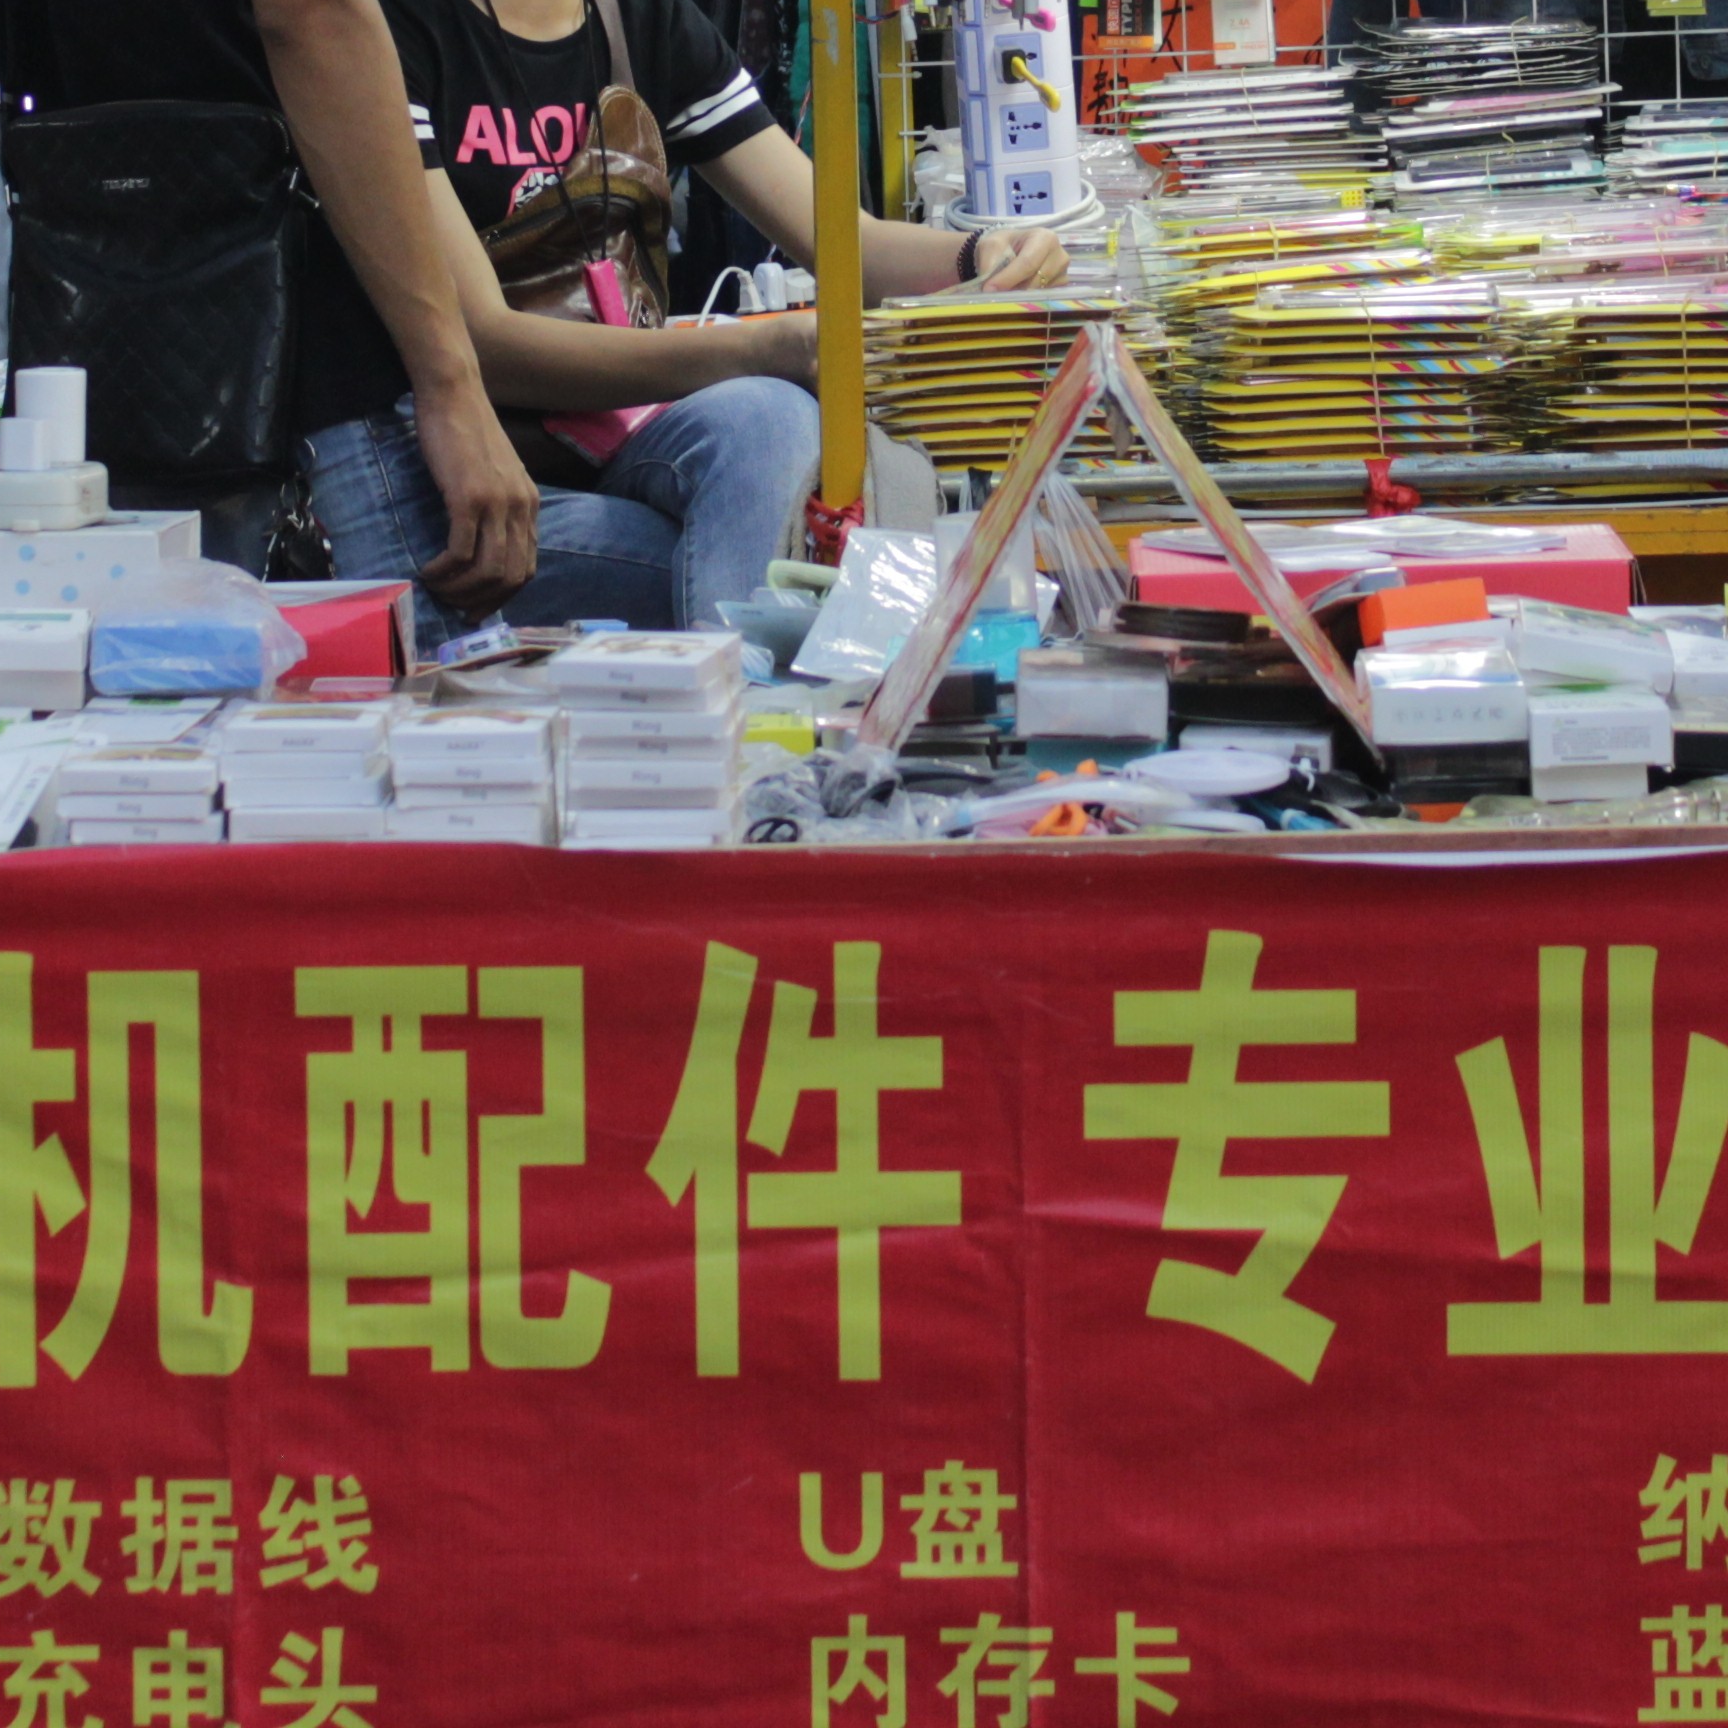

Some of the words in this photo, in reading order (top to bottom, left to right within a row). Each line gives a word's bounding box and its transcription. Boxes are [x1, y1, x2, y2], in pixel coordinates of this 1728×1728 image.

[798, 1460, 1020, 1580] U盘
[808, 1610, 1191, 1728] 内存卡
